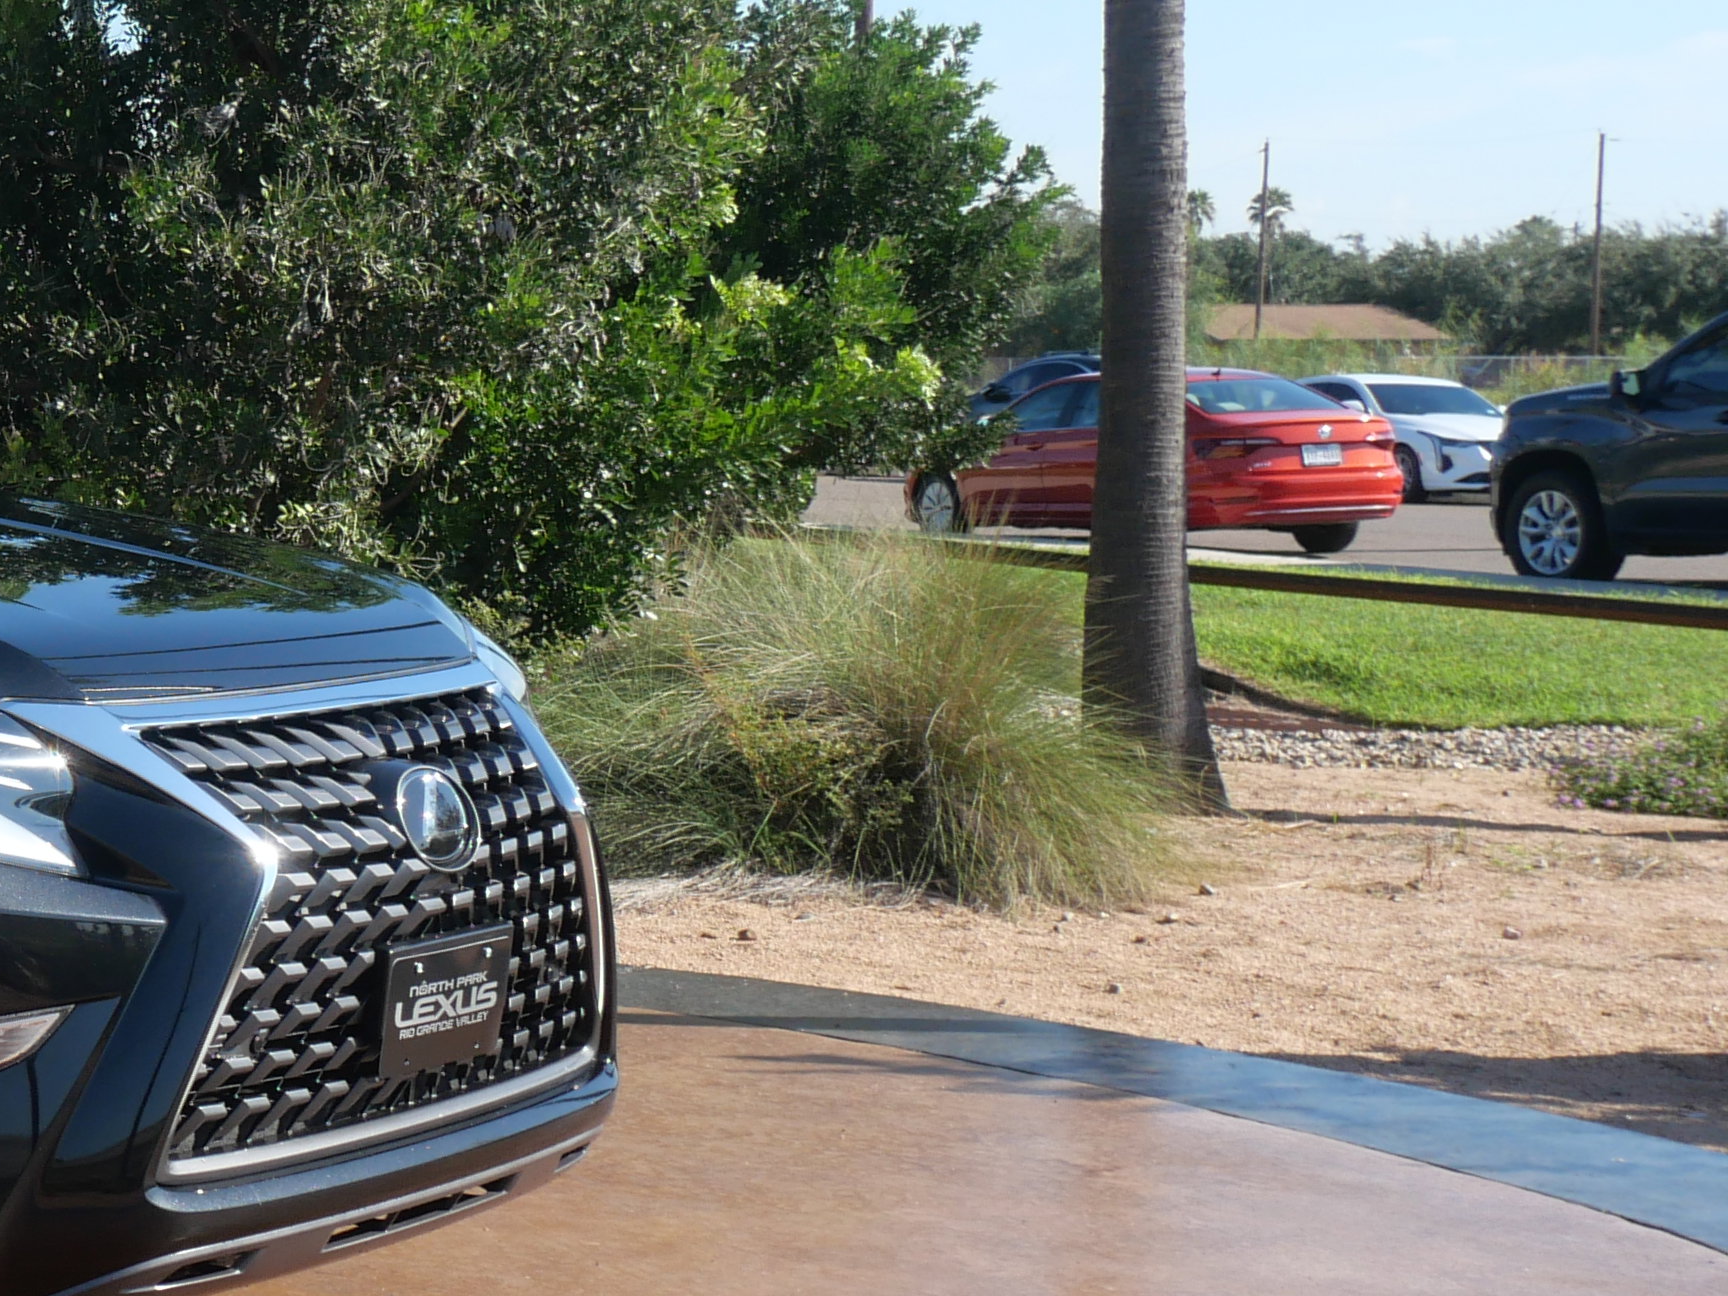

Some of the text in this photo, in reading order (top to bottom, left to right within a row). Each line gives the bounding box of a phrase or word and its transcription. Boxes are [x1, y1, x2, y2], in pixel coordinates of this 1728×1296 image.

[456, 971, 488, 988] PARK
[394, 981, 498, 1028] LEXUS
[399, 1011, 488, 1040] RIO GRANDE VALLEY
